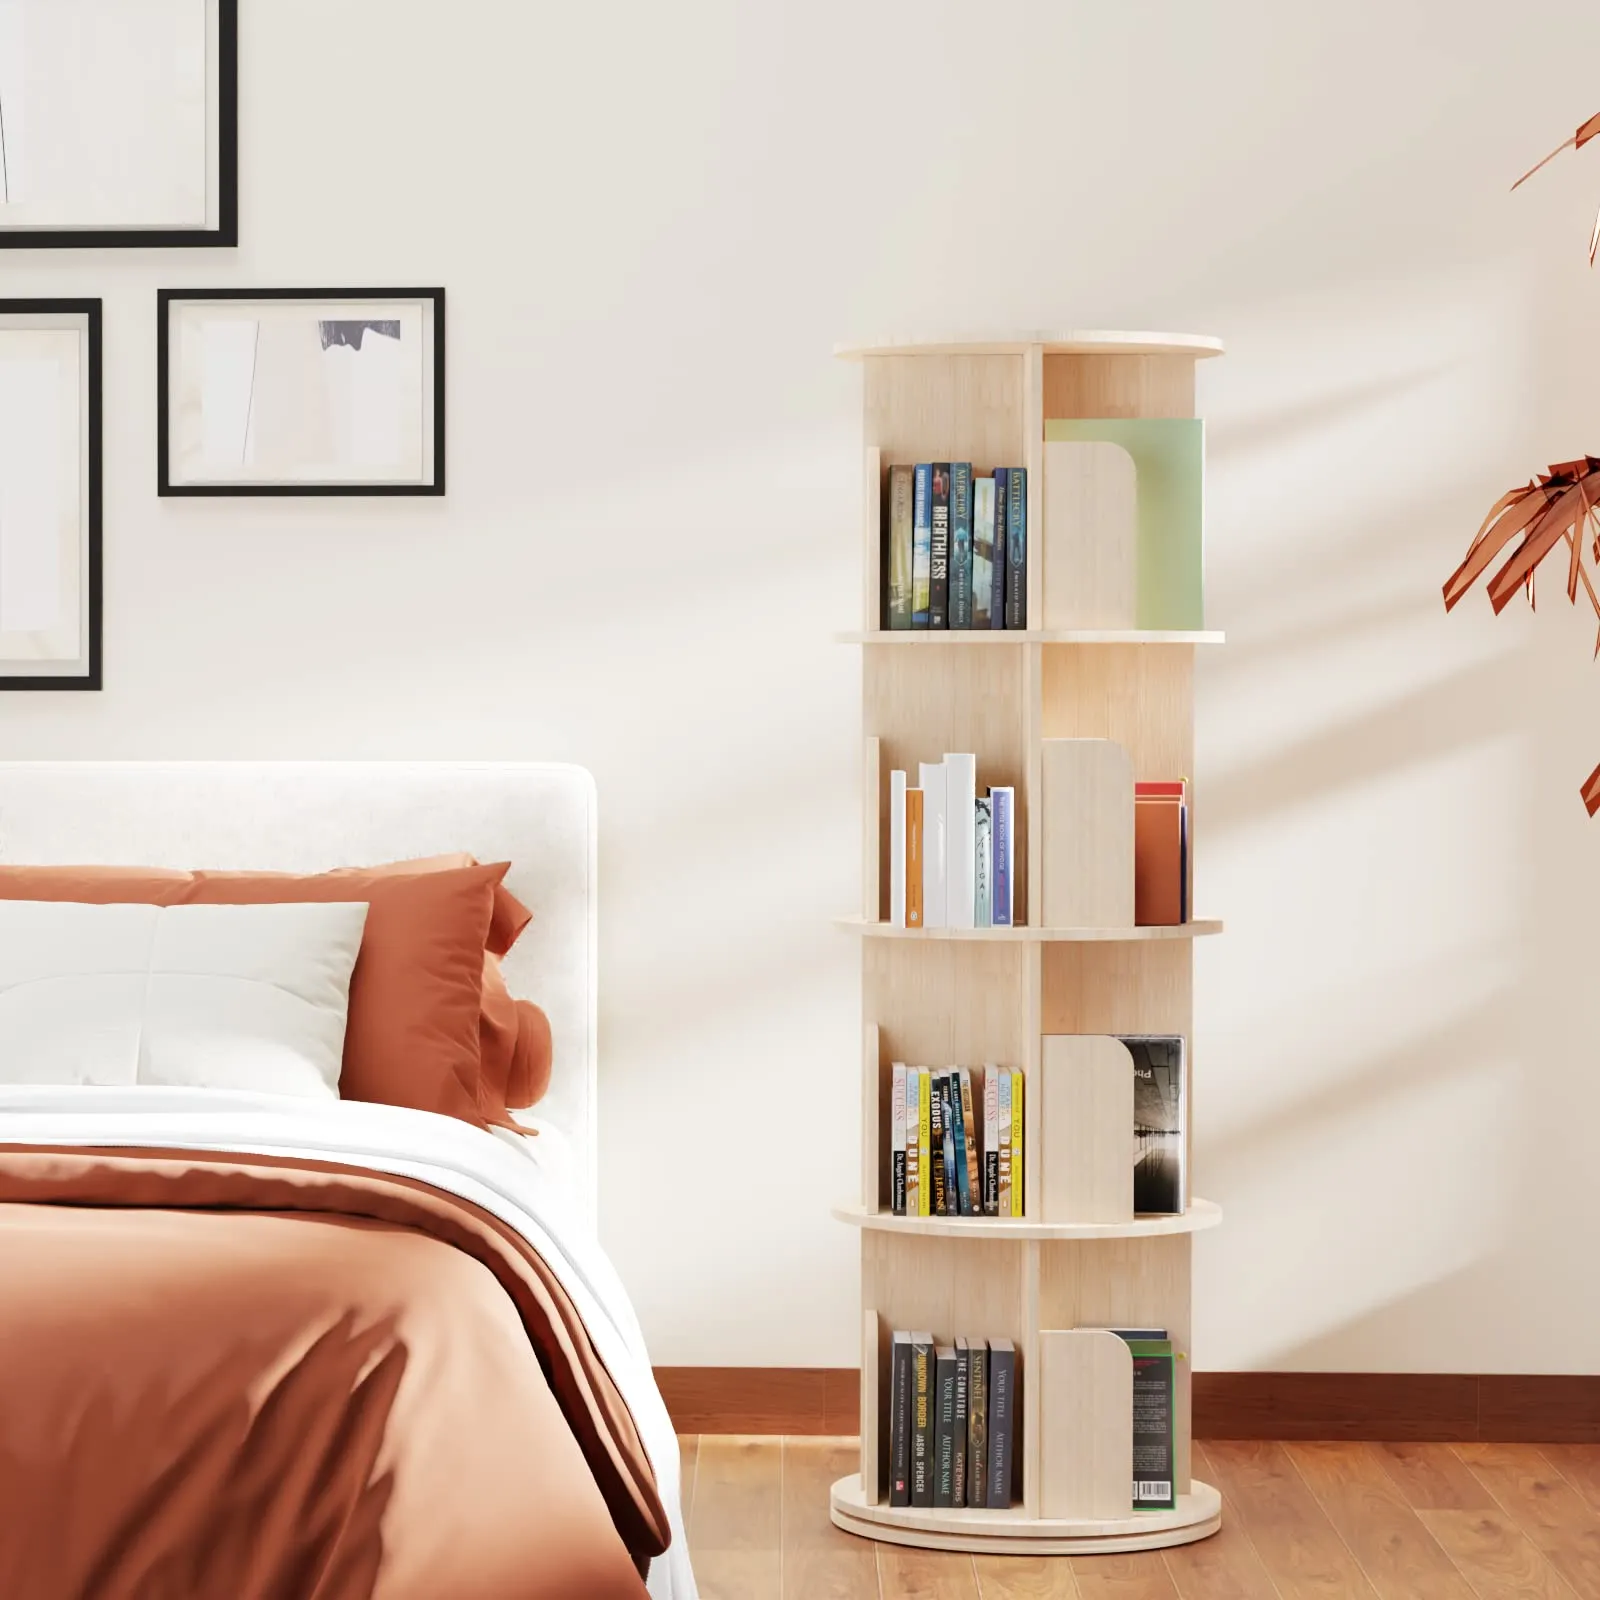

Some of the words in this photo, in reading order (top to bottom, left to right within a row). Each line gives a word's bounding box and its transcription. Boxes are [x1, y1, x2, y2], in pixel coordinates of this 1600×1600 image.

[956, 469, 968, 519] MERCURY
[1011, 471, 1020, 527] BATTLECRY
[932, 505, 948, 580] BREATHLESS
[999, 842, 1005, 850] OF
[895, 1078, 905, 1121] SUCCESS
[931, 1091, 942, 1129] EXODUS
[987, 1078, 997, 1121] SUCCESS
[907, 1135, 918, 1183] DUNE
[1000, 1135, 1011, 1183] DUNE
[936, 1187, 945, 1210] PENN
[917, 1353, 927, 1393] UNKNOWN
[957, 1357, 967, 1372] THE
[973, 1356, 982, 1399] SENTINEL
[943, 1377, 954, 1400] YOUR
[956, 1376, 967, 1419] COMATOSE
[997, 1369, 1007, 1394] YOUR
[917, 1396, 927, 1428] BORDER
[943, 1402, 952, 1423] TITLE
[996, 1396, 1005, 1418] TITLE
[916, 1434, 925, 1457] JASON
[942, 1435, 952, 1470] AUTHOR
[995, 1432, 1005, 1468] AUTHOR
[916, 1461, 925, 1493] SPENCER
[955, 1452, 963, 1474] KATE
[941, 1471, 951, 1495] NAME
[994, 1470, 1004, 1495] NAME
